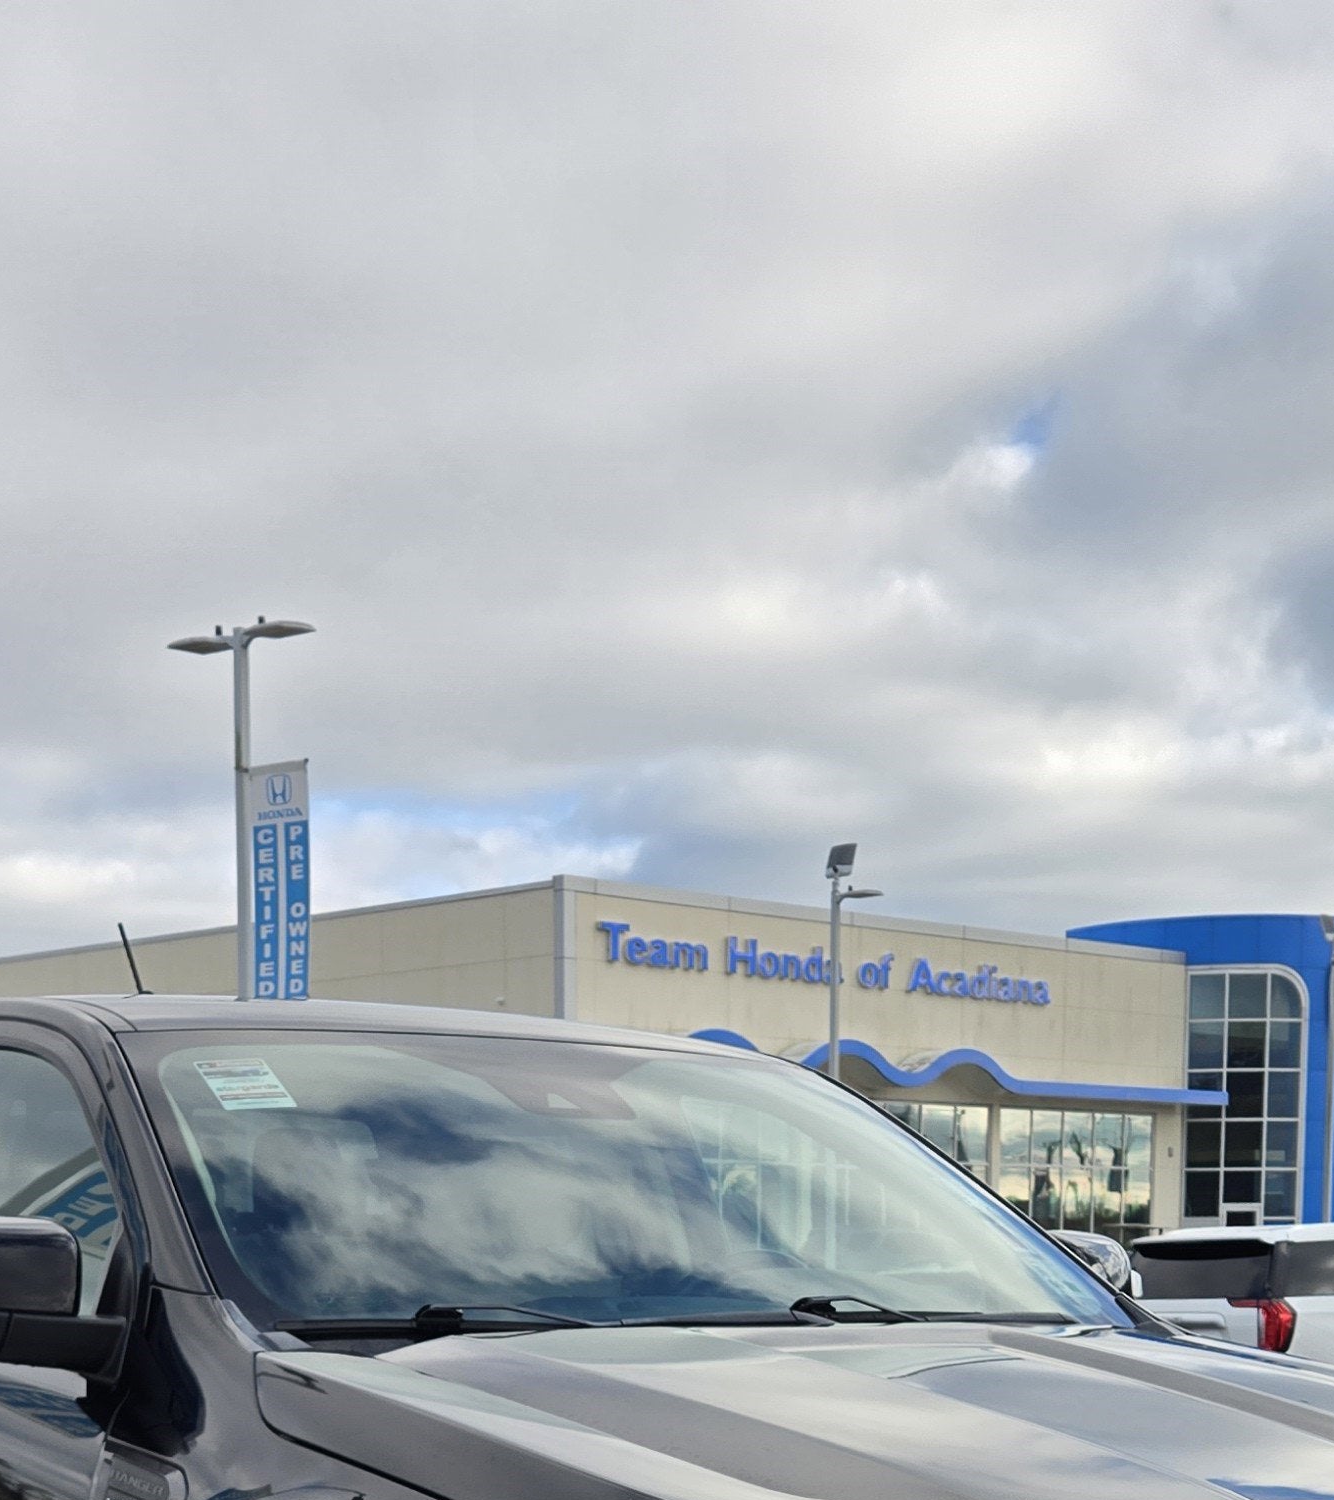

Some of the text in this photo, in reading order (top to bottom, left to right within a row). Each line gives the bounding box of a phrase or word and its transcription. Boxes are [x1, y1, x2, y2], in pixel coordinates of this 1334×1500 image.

[257, 807, 303, 821] HONDA
[257, 828, 275, 997] CERTIFIED
[288, 825, 307, 994] PRE OWNED
[597, 920, 709, 972] Team
[858, 953, 895, 990] of
[907, 957, 1053, 1006] Acadiana
